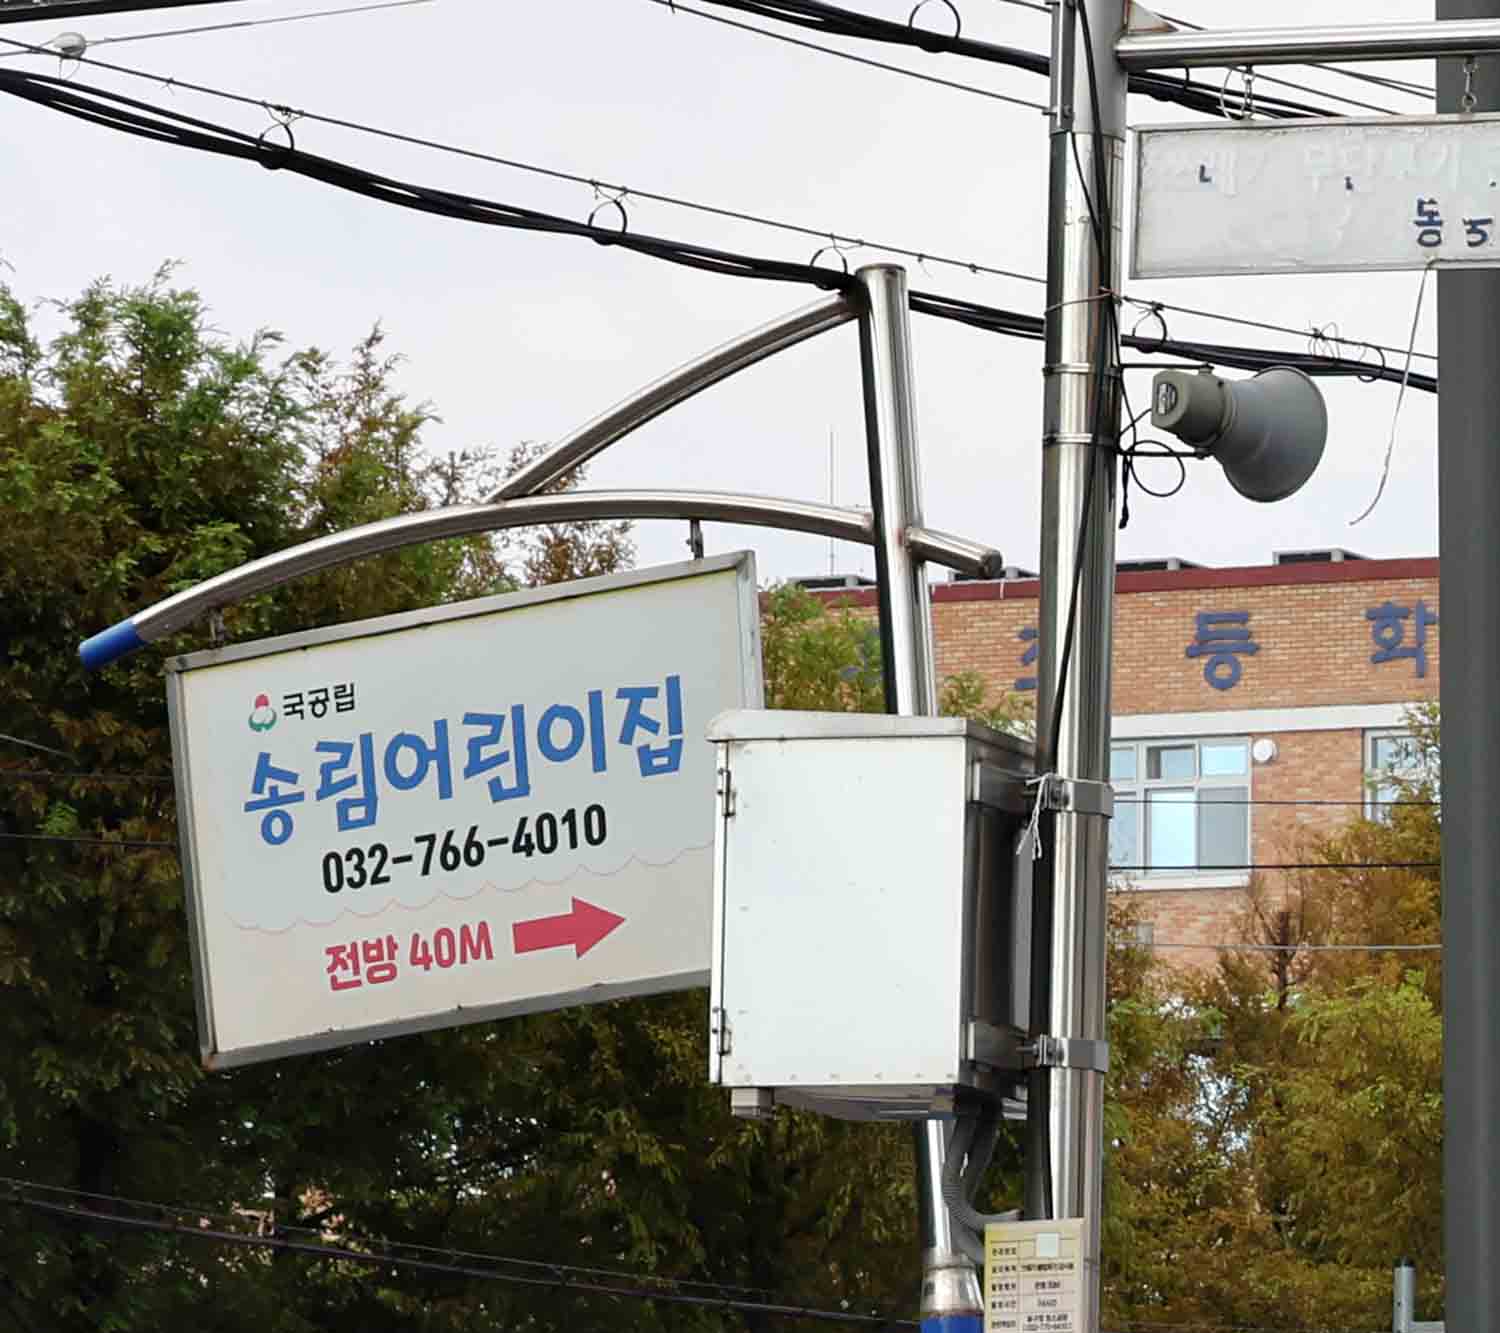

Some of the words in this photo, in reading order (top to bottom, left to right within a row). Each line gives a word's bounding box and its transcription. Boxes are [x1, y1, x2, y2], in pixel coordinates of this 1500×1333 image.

[283, 683, 357, 720] 국공립
[244, 674, 685, 845] 송림어린이집
[322, 803, 607, 893] 032-766-4010
[325, 939, 399, 991] 전방
[409, 920, 493, 971] 40M
